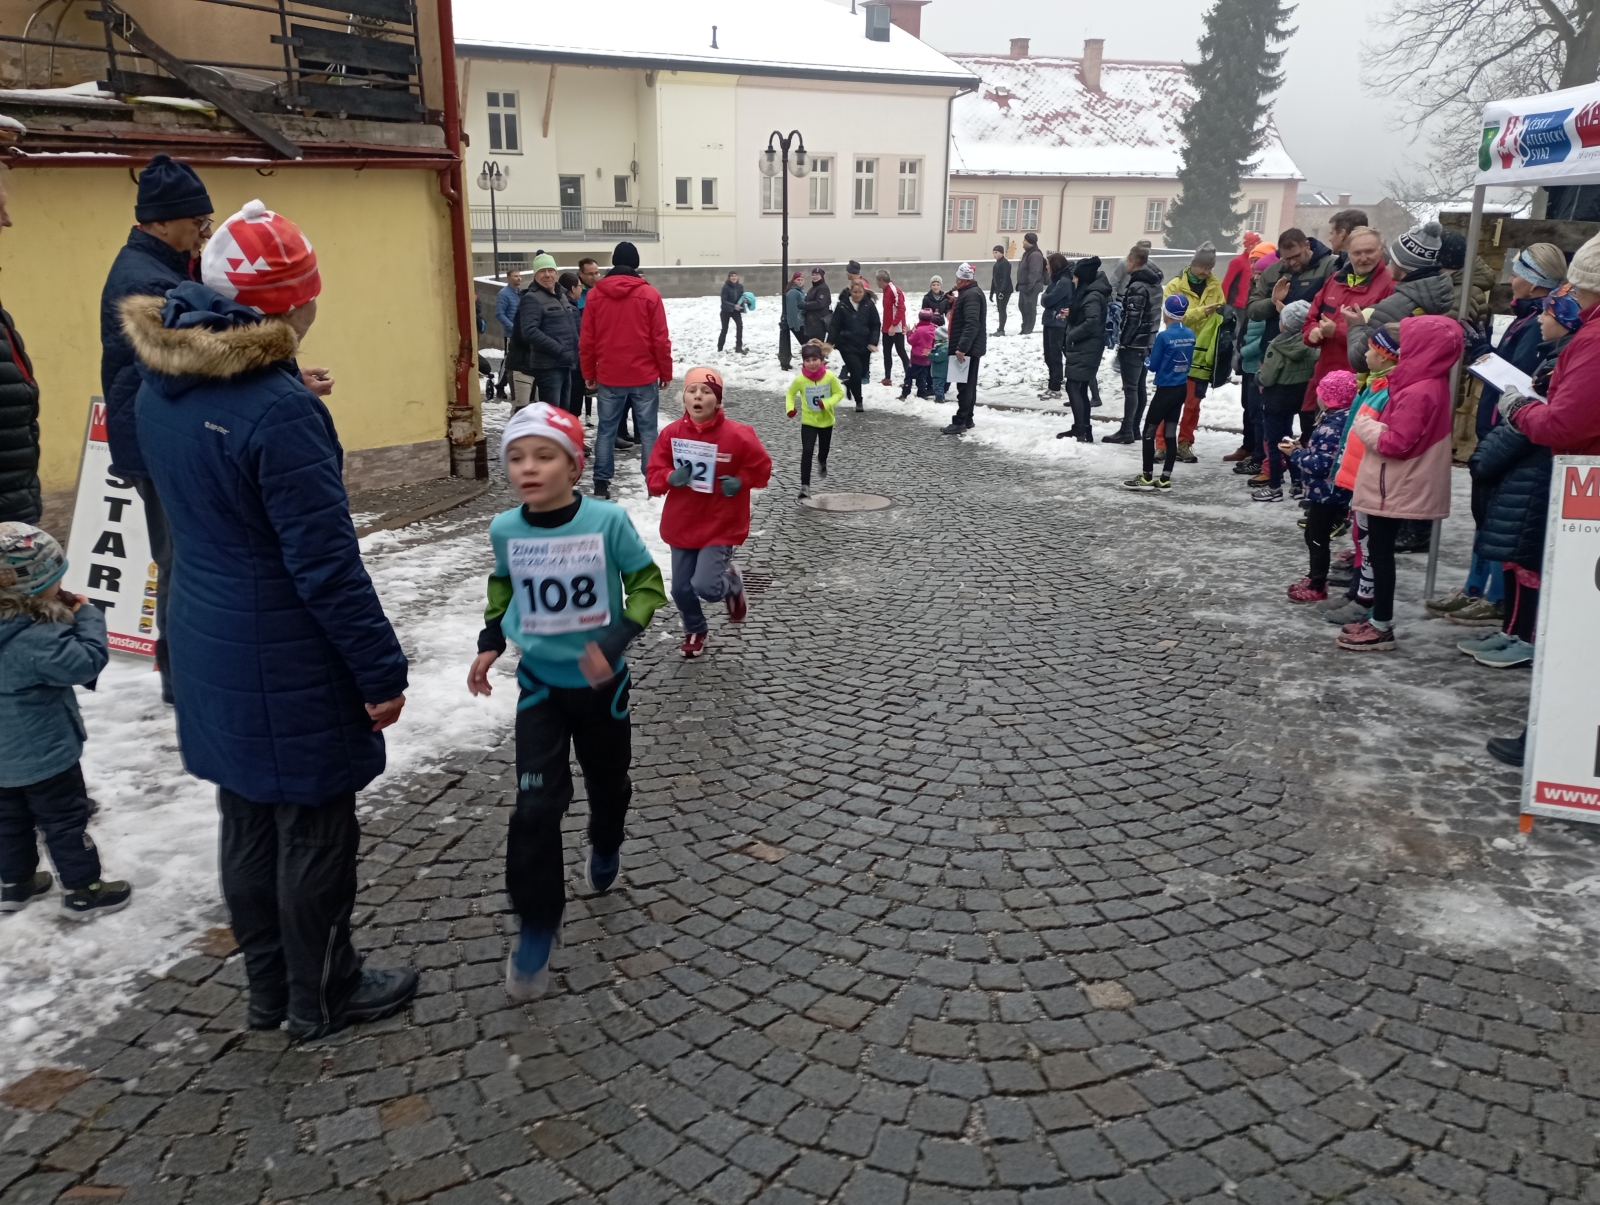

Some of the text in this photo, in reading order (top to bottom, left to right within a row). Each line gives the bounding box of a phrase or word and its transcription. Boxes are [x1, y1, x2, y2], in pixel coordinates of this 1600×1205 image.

[1528, 115, 1555, 130] ČESKÝ
[1526, 127, 1566, 146] ATLETICKÝ
[1531, 147, 1550, 160] SVAZ
[522, 576, 598, 614] 108
[107, 634, 153, 652] onstav.cz
